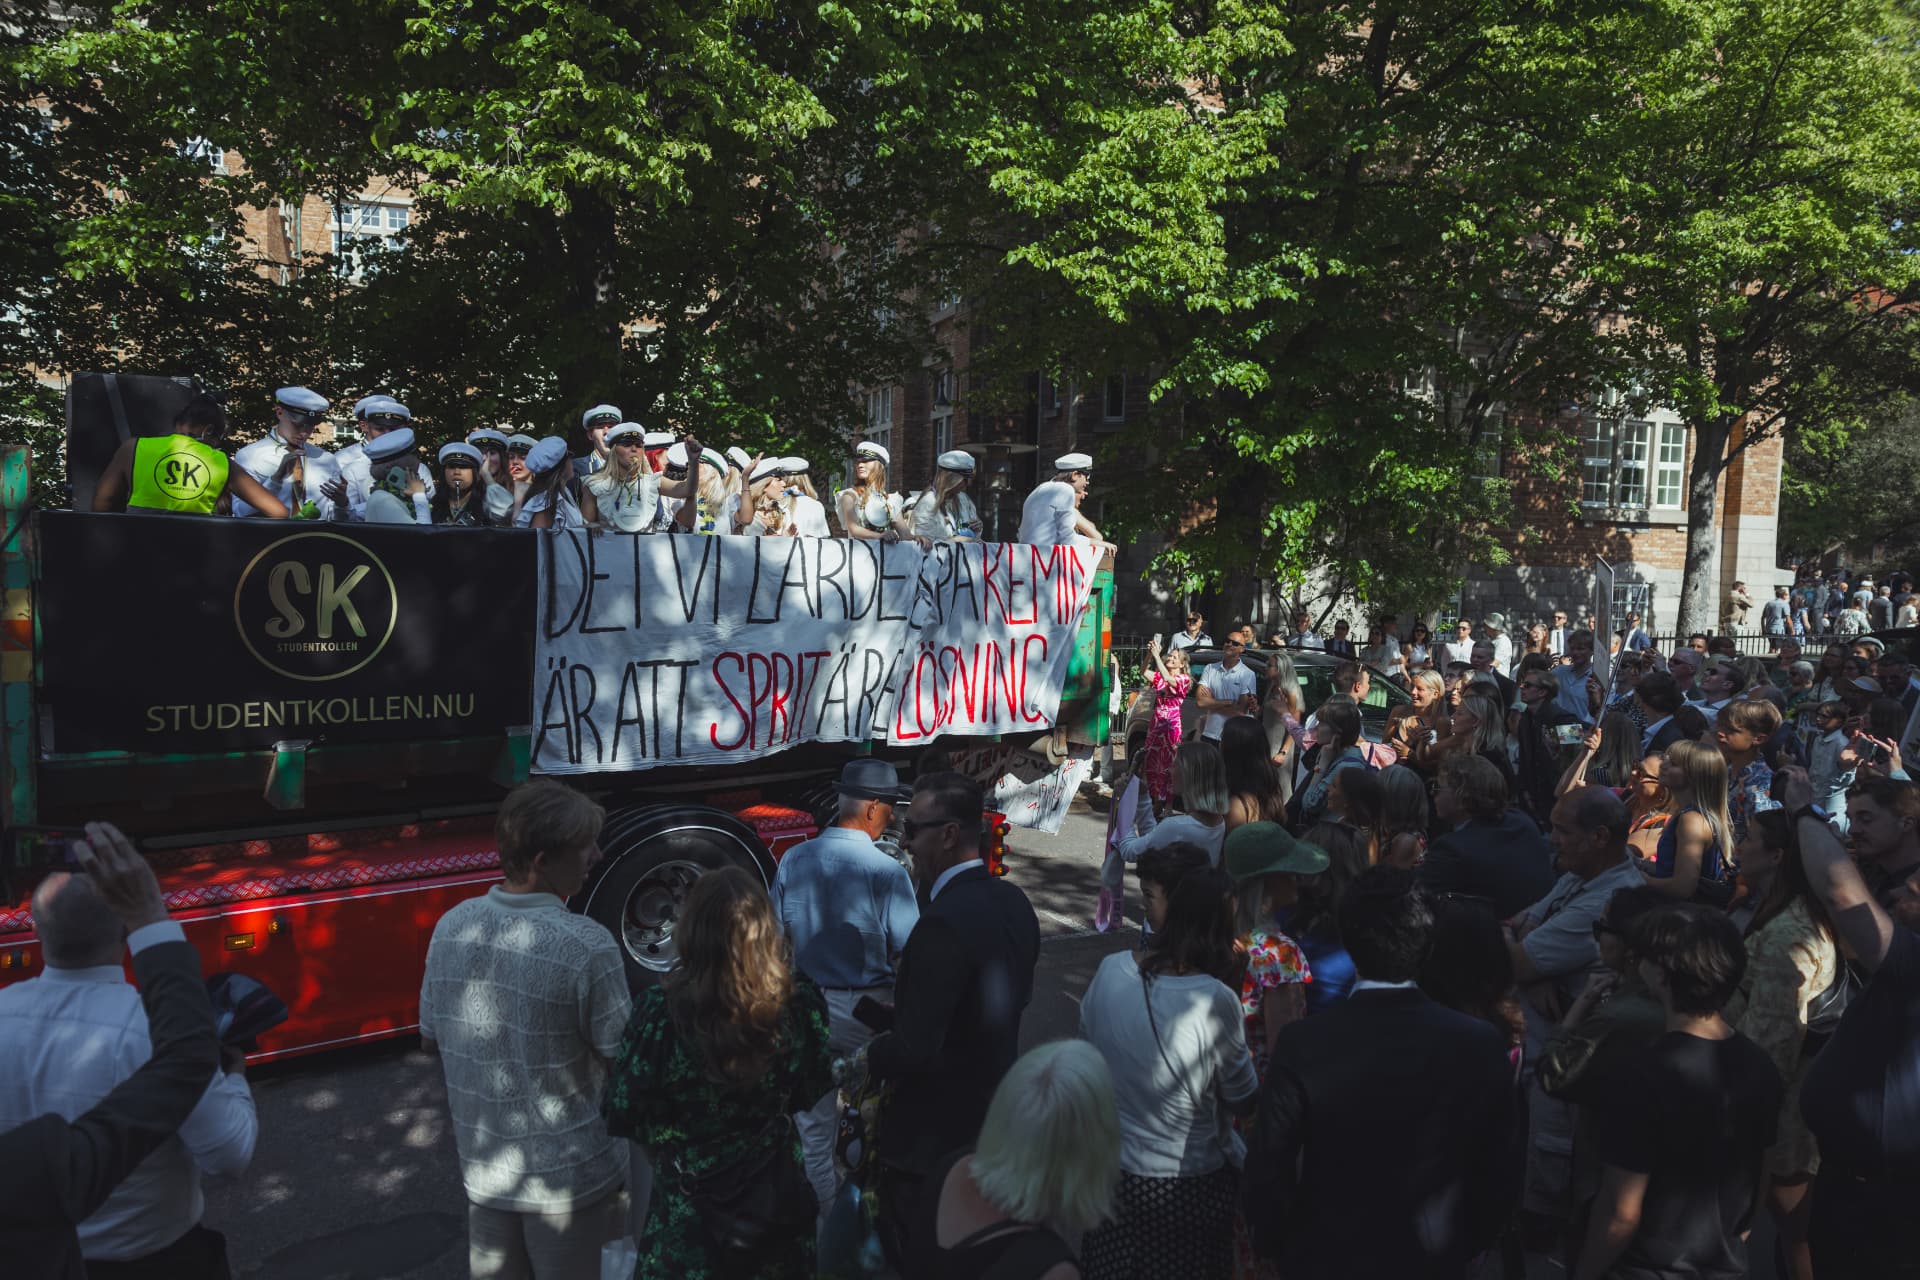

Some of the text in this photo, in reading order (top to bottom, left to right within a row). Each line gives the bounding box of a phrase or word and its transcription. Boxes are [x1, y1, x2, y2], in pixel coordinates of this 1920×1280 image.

[164, 460, 201, 488] SK
[264, 560, 371, 639] SK
[543, 529, 657, 640] DET
[668, 533, 722, 625] VI
[277, 641, 358, 653] STUDENTKOLLEN
[146, 692, 475, 732] STUDENTKOLLEN.NU
[531, 655, 604, 765] ÄR
[611, 659, 700, 763] ATT
[709, 651, 832, 751] SPRIT
